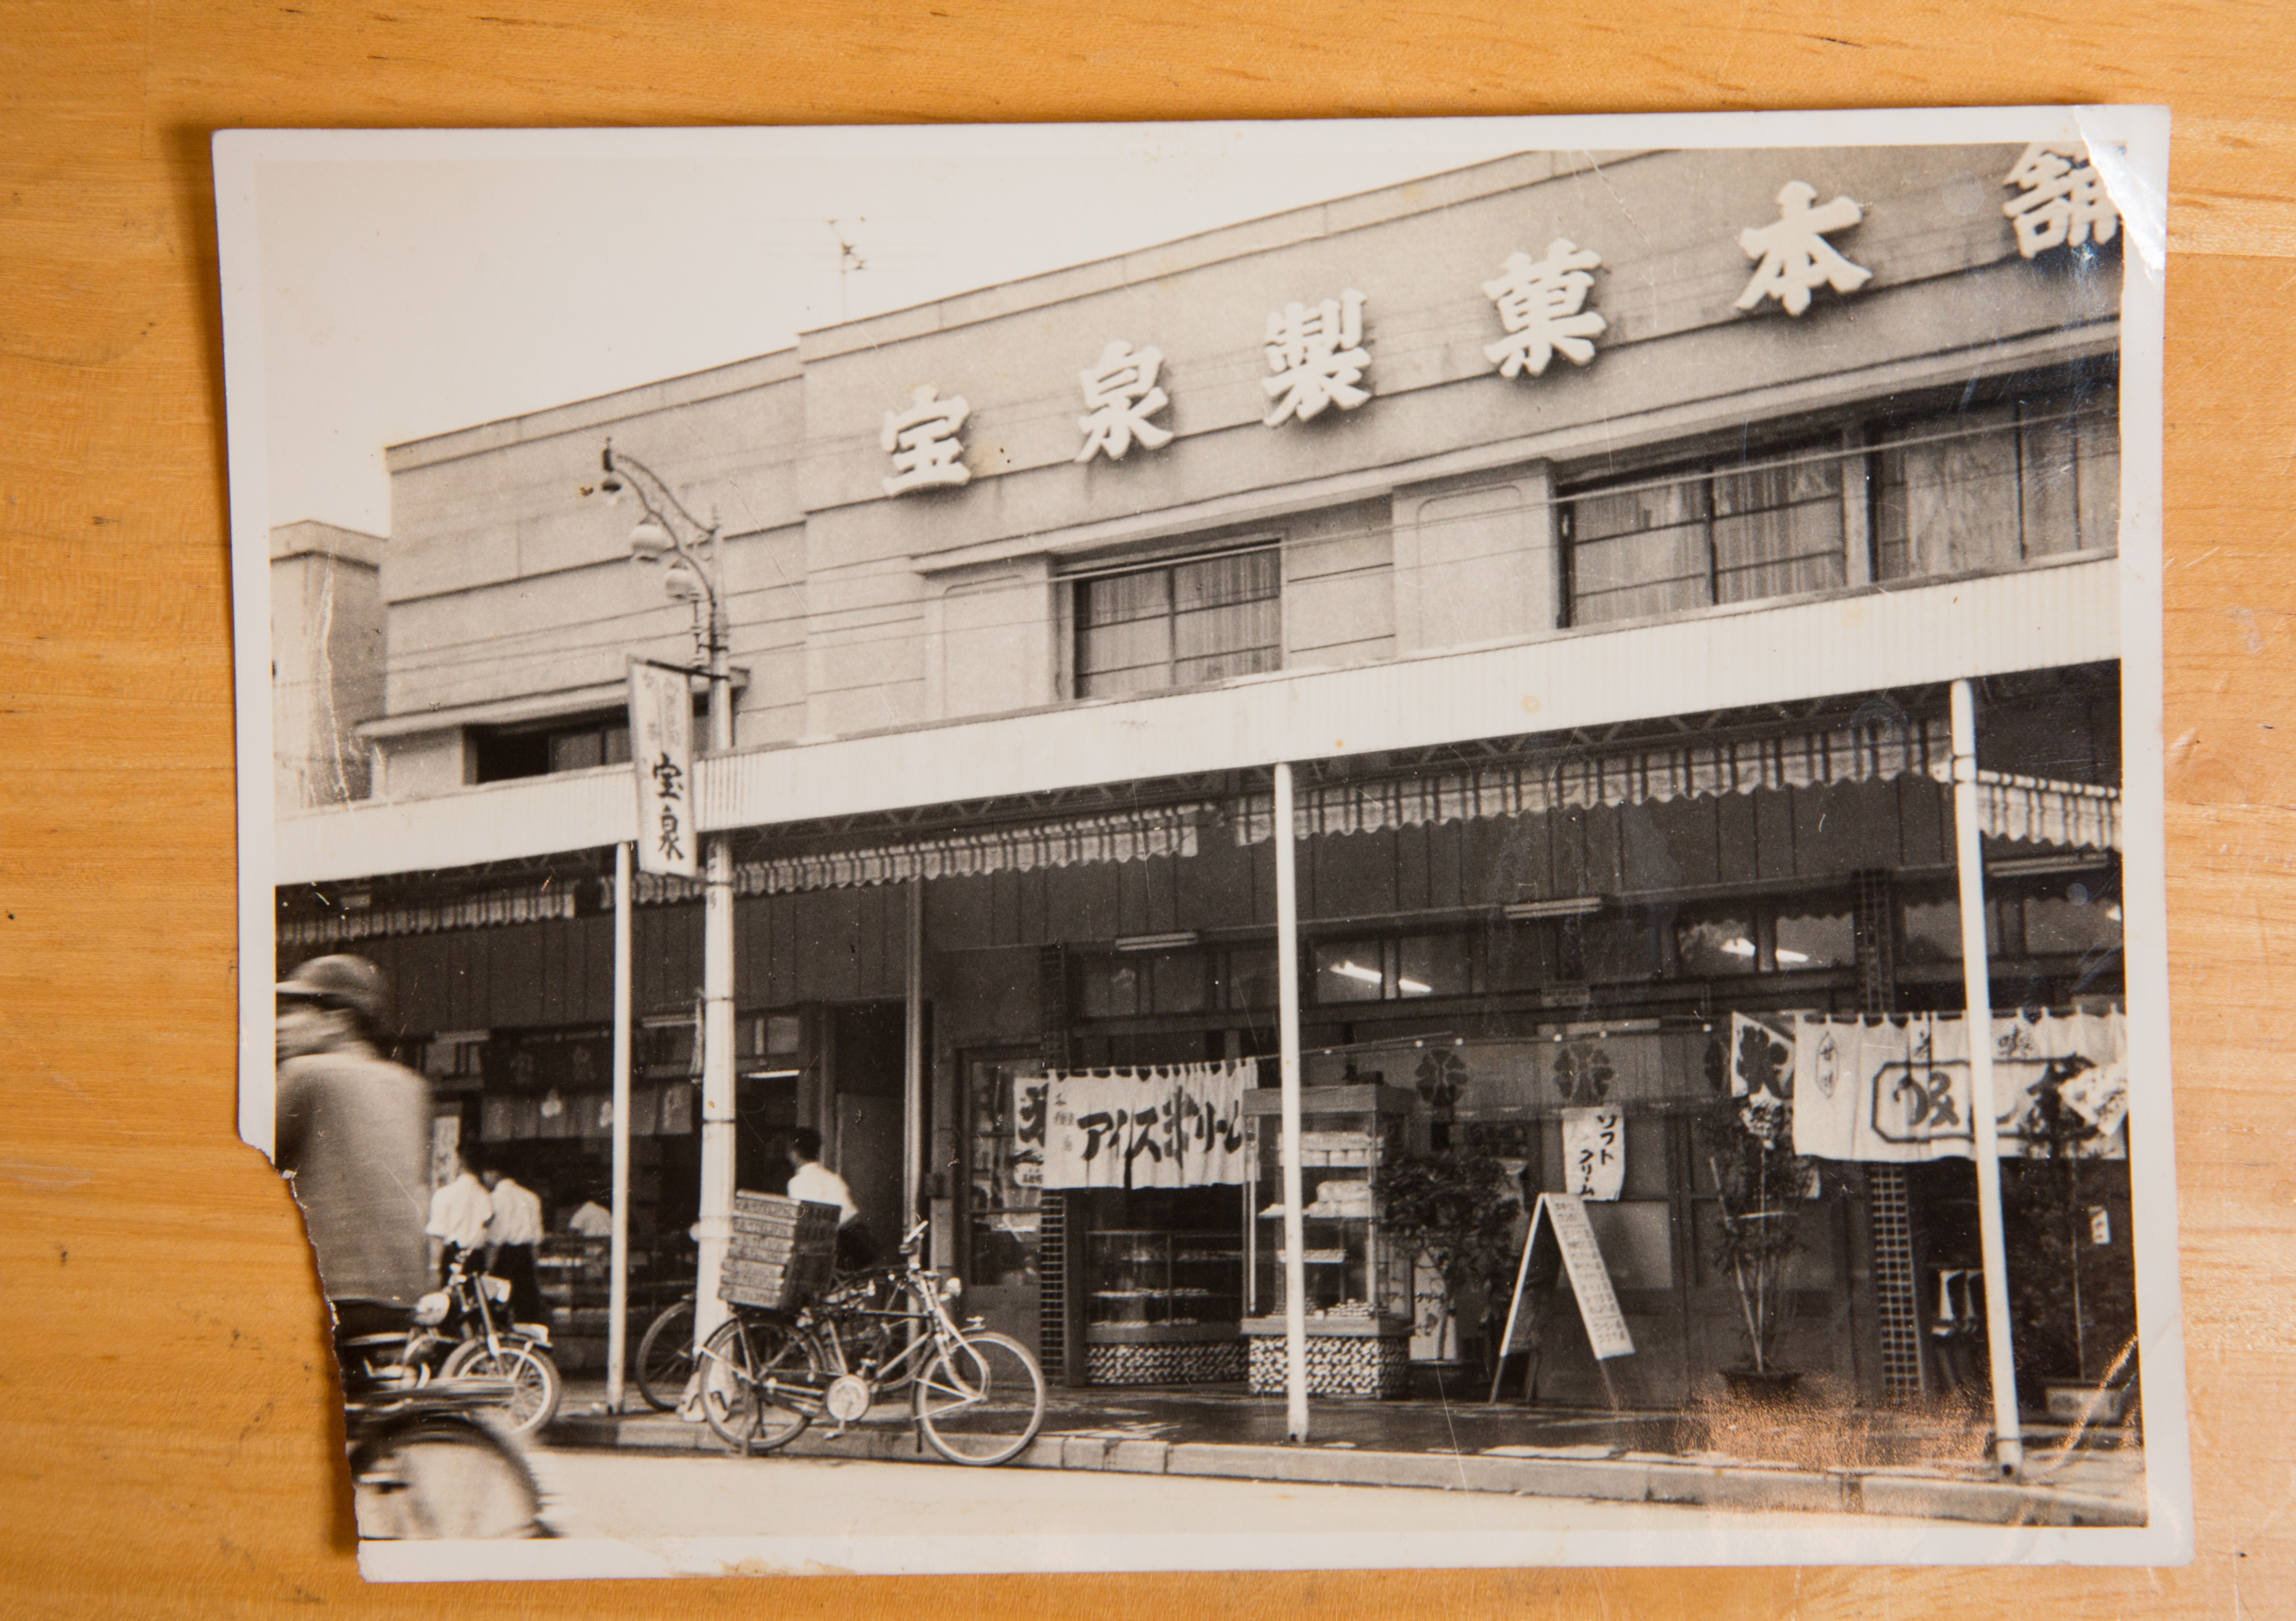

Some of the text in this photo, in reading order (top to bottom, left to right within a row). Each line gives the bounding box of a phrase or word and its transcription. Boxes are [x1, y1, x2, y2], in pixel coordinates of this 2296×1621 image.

[653, 752, 684, 860] 宝泉
[1597, 1114, 1618, 1165] ソフト
